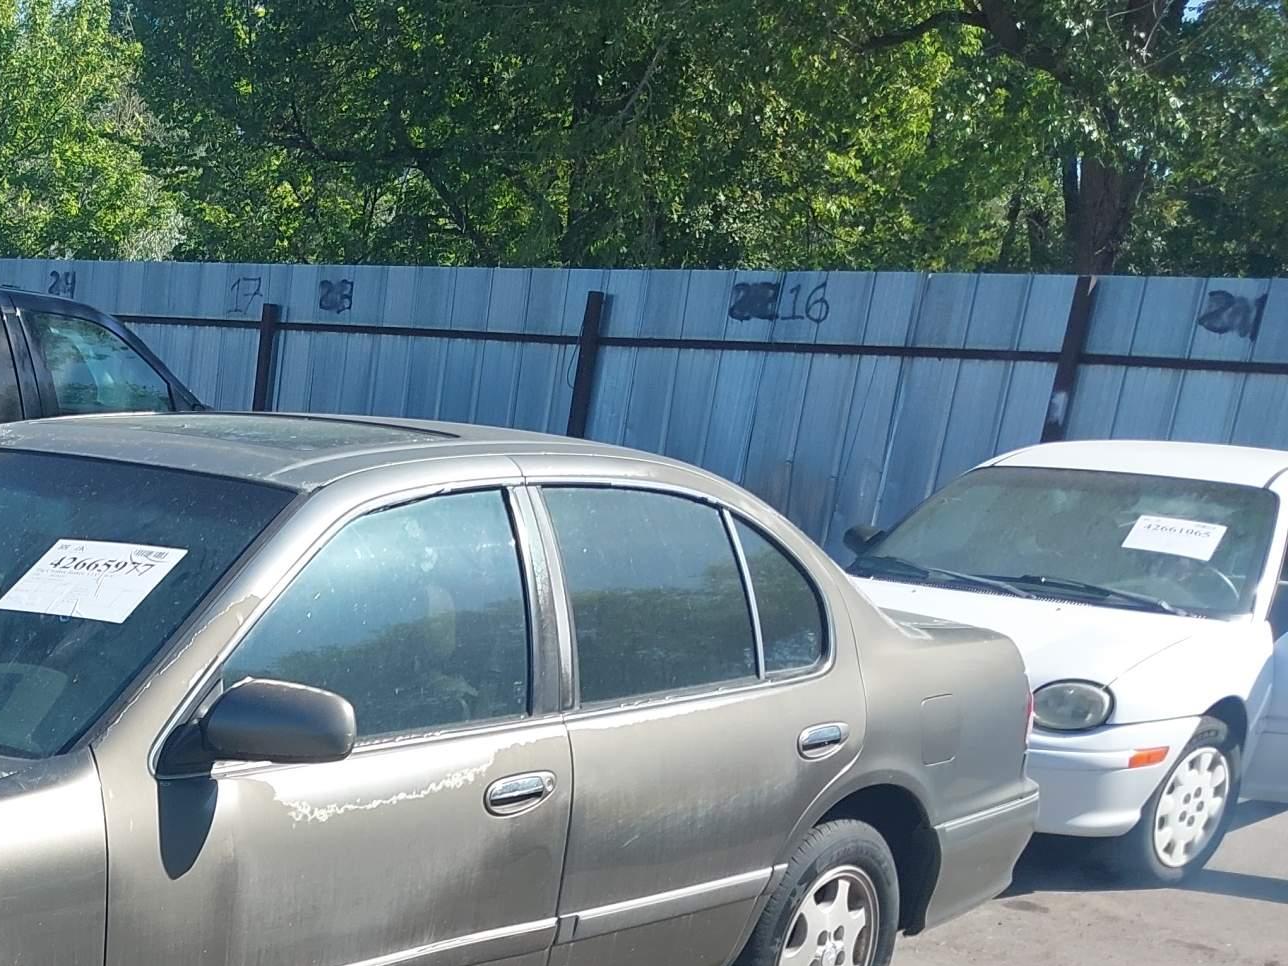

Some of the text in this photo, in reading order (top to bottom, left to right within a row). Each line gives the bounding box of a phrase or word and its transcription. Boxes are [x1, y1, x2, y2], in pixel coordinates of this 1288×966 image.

[226, 276, 263, 315] 17
[781, 281, 830, 323] 16
[49, 556, 157, 577] 42665977
